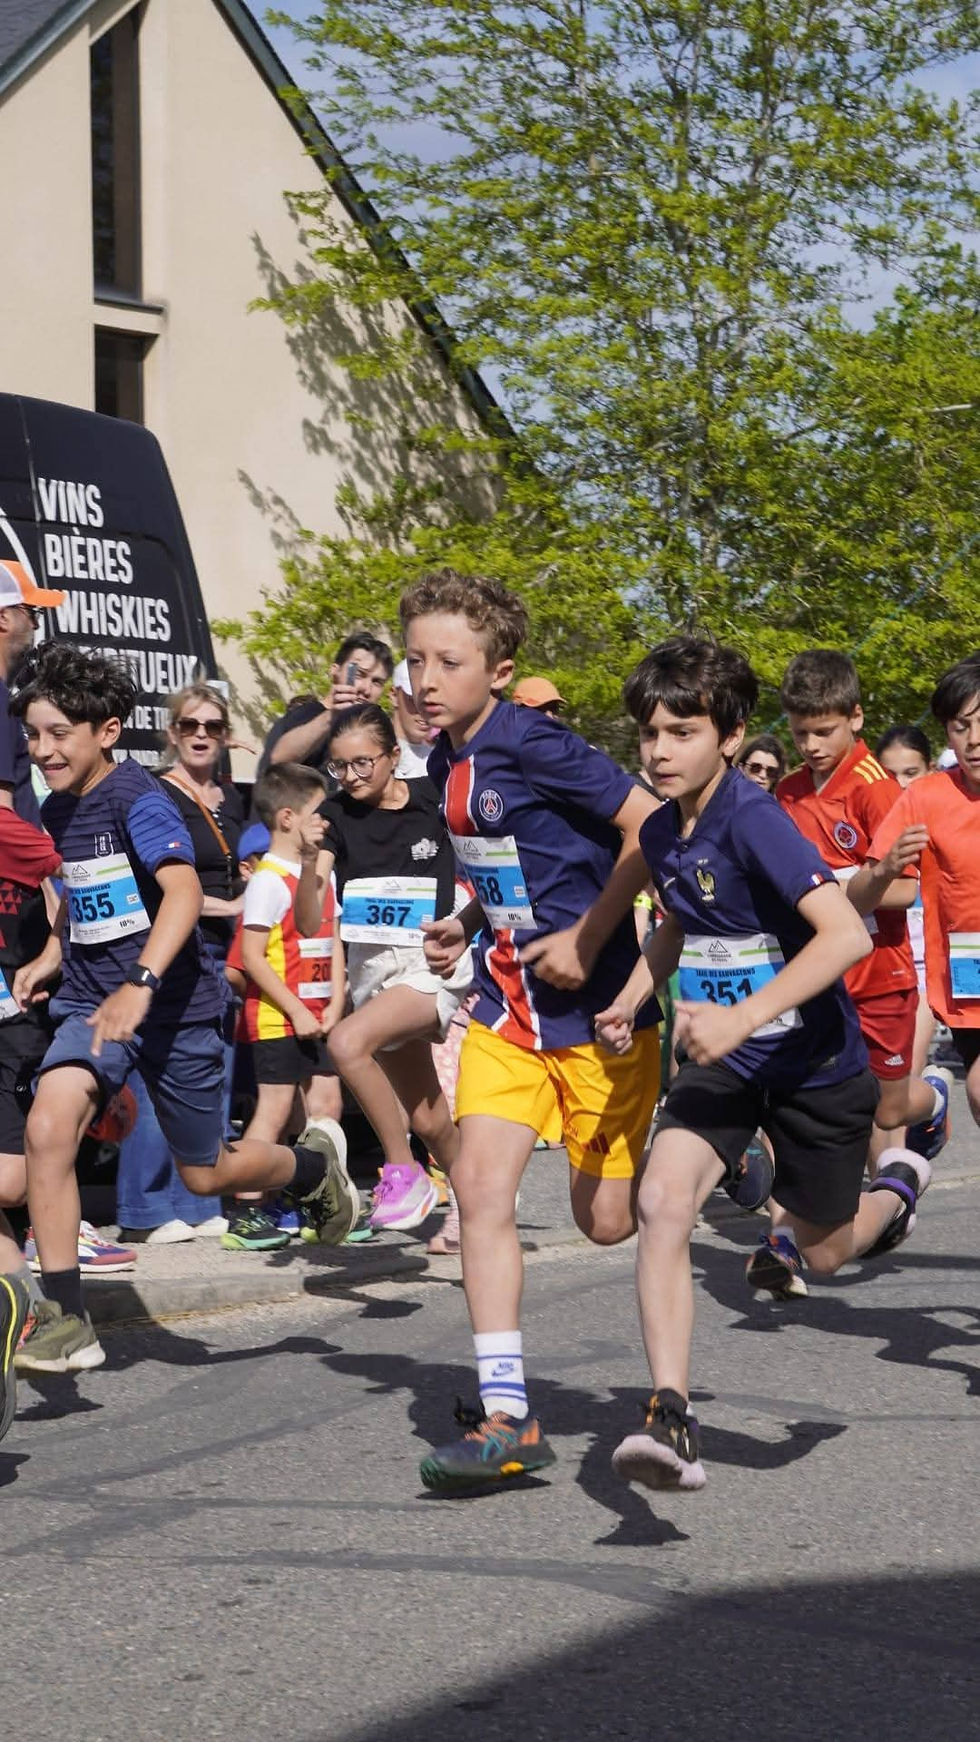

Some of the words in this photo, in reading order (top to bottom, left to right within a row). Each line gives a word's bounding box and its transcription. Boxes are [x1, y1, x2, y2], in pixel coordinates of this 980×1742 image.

[38, 477, 104, 528] VINS
[44, 527, 134, 584] BIÈRES
[52, 589, 171, 642] WHISKIES
[135, 705, 153, 730] DE
[71, 892, 115, 922] 355
[366, 904, 411, 927] 367
[700, 978, 753, 1008] 351
